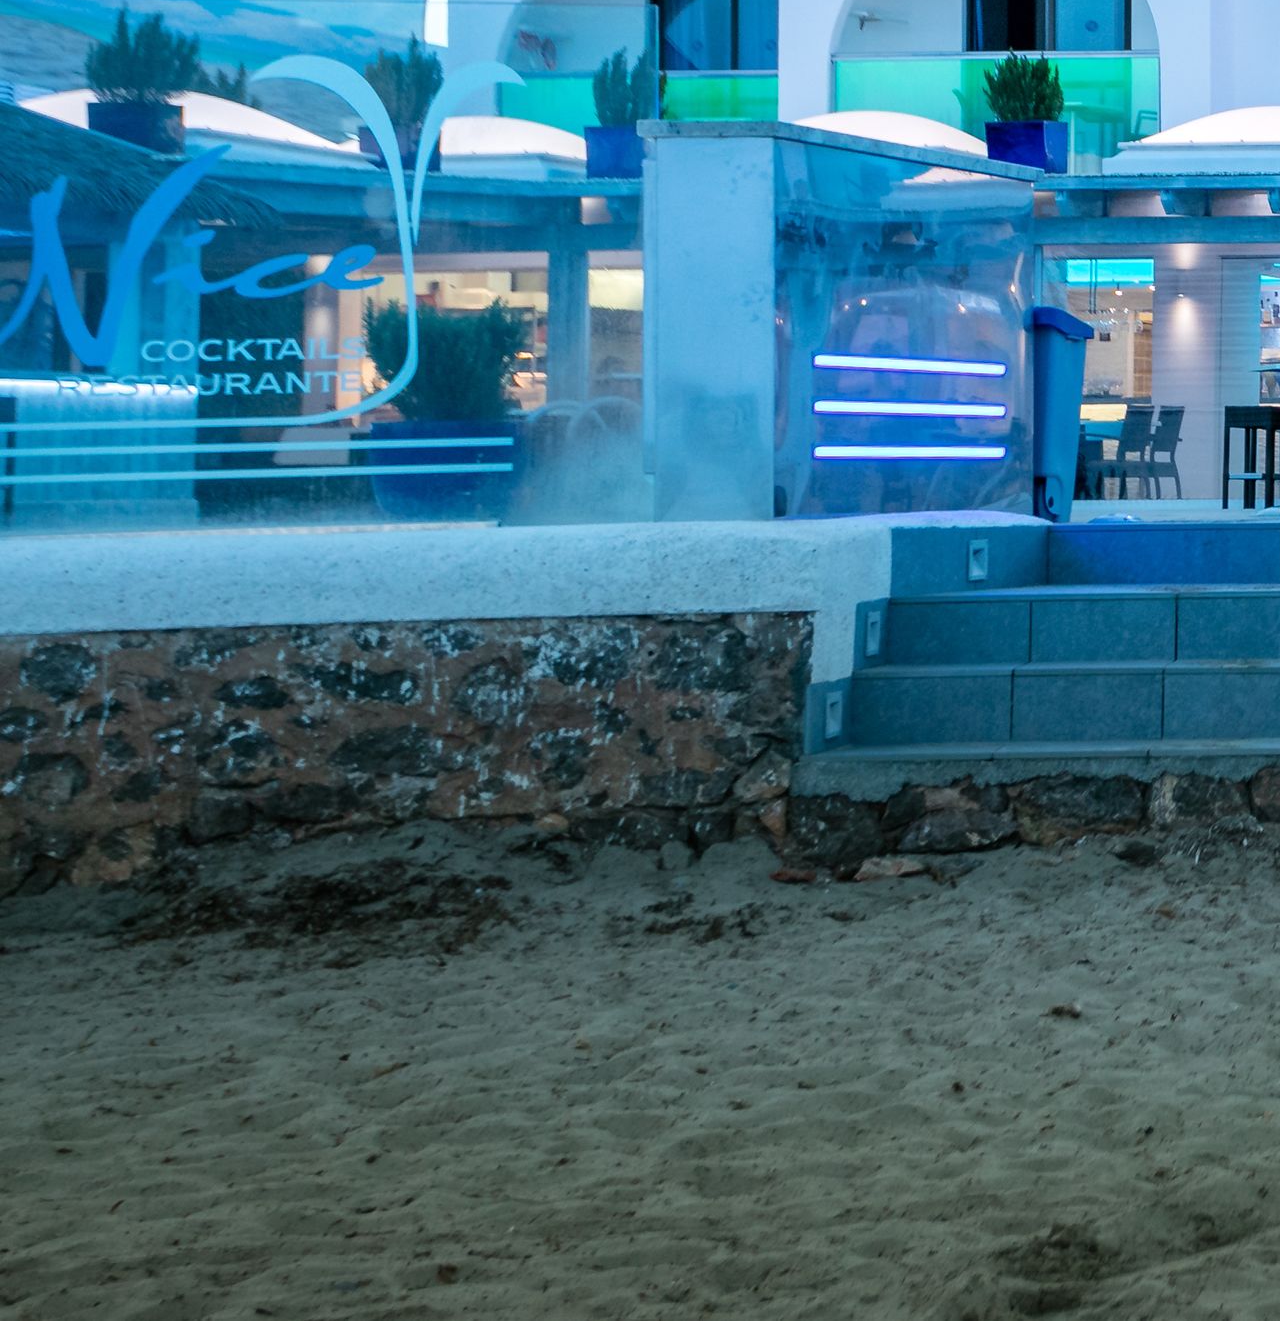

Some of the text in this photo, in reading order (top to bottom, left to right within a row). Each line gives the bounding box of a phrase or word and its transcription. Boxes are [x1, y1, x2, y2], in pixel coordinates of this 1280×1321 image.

[0, 143, 385, 367] Nice
[141, 337, 366, 362] COCKTAILS
[55, 371, 363, 396] RESTAURANTE
